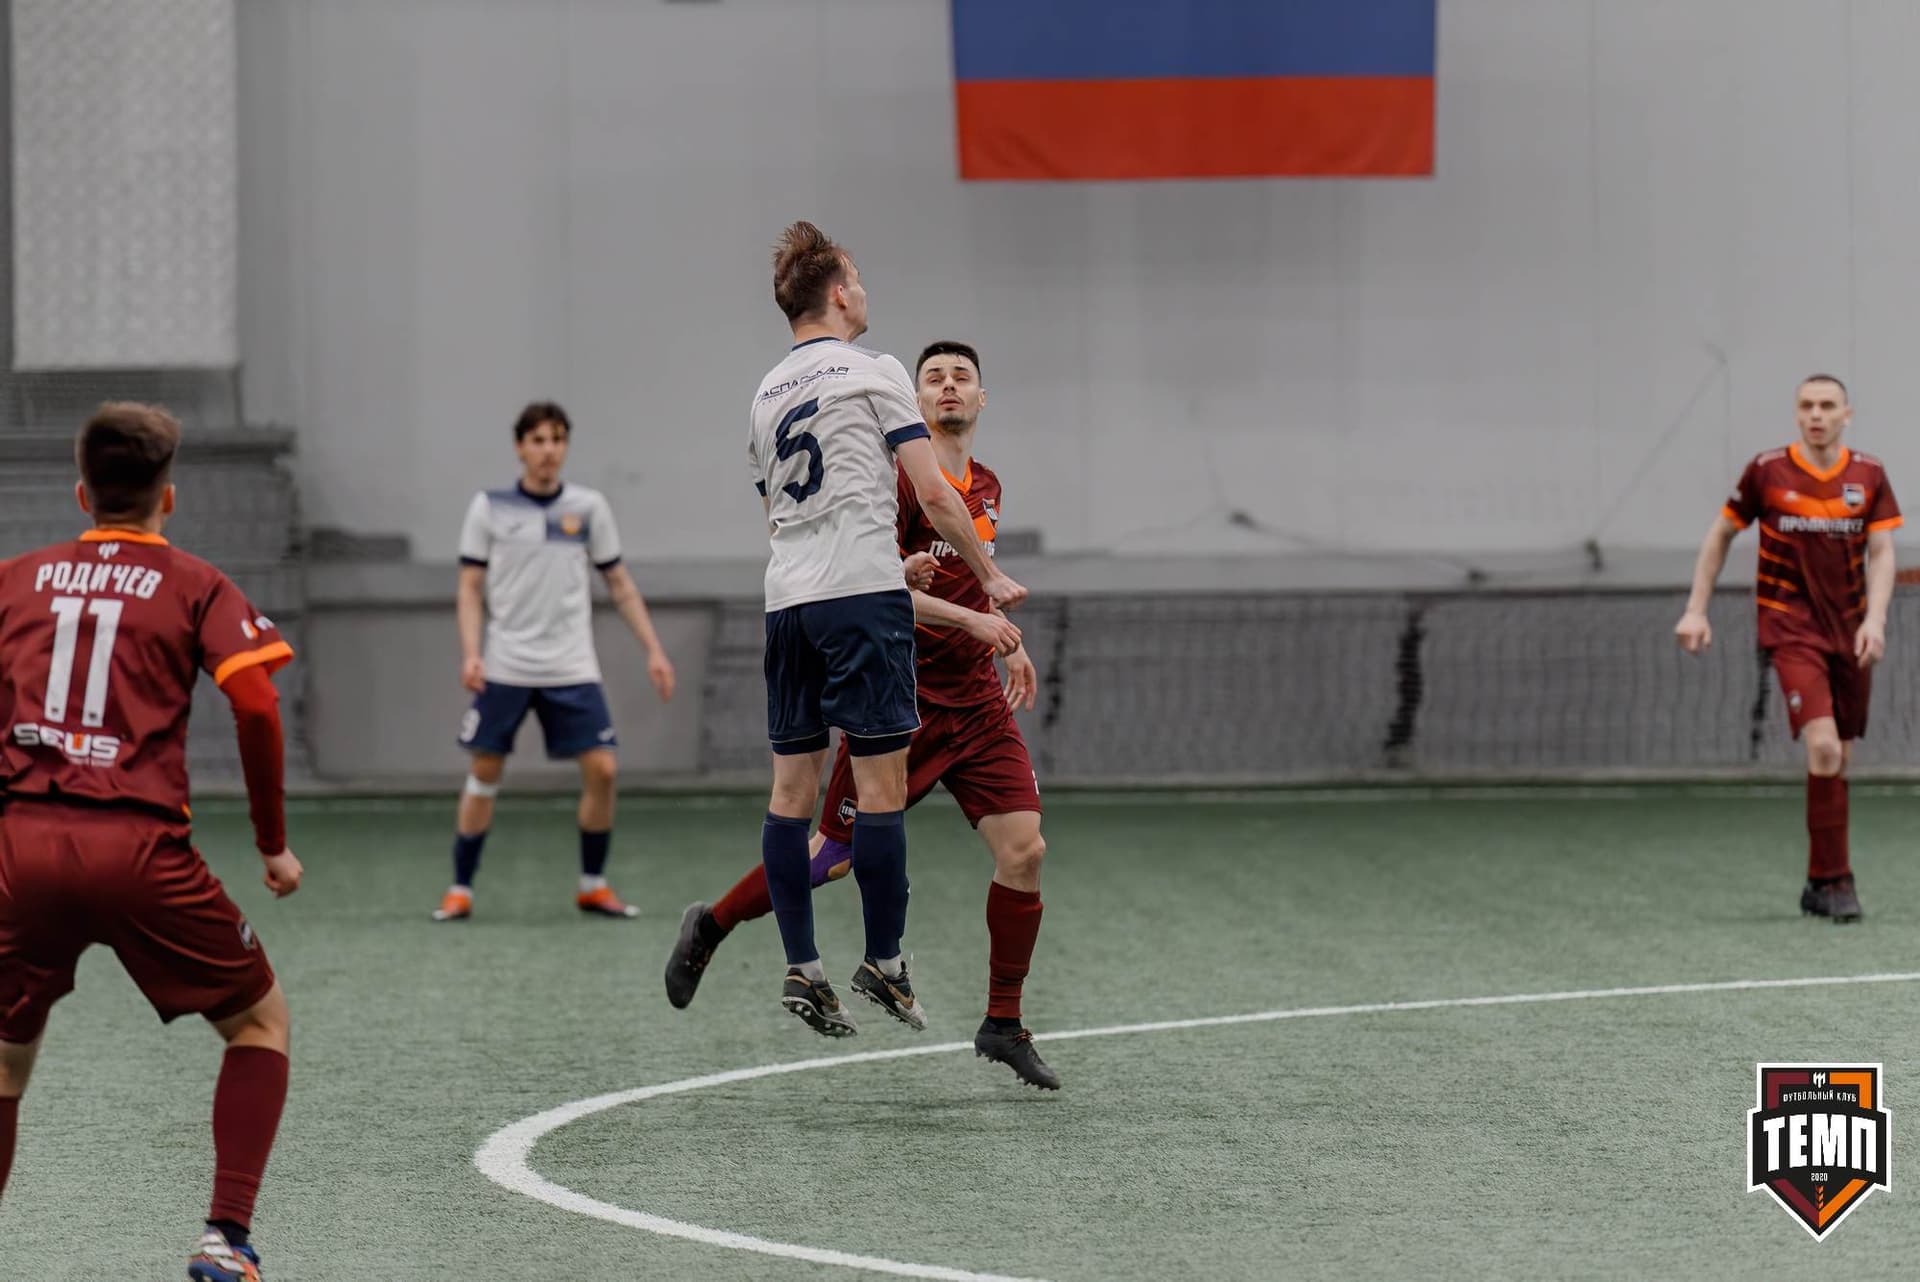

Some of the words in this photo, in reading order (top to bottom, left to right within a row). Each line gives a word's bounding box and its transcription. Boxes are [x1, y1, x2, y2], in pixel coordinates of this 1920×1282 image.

[776, 397, 824, 504] 5
[35, 561, 162, 599] РОДИЧЕВ
[44, 596, 124, 728] 11
